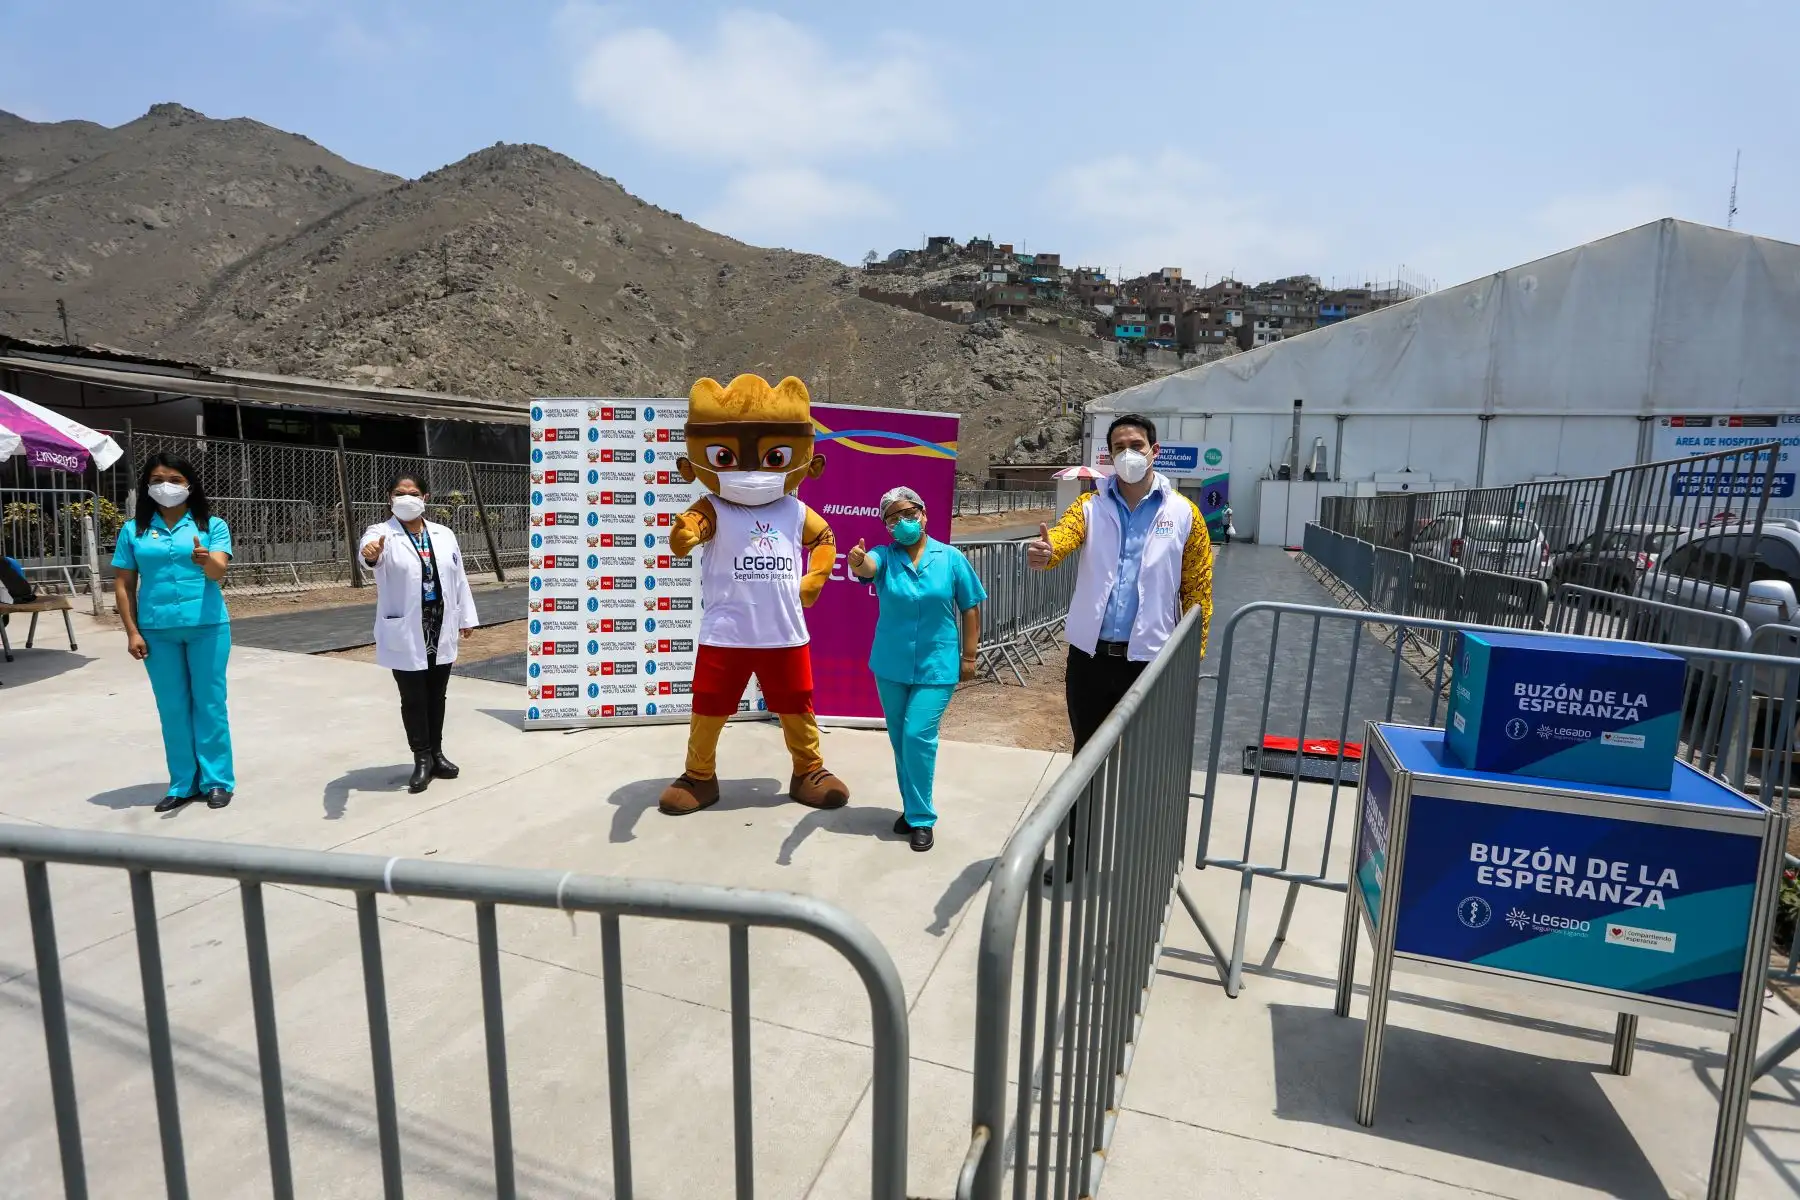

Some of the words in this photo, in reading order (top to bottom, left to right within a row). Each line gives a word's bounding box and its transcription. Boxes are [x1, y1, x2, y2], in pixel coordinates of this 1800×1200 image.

[1676, 436, 1701, 446] ÁREA
[1704, 438, 1716, 446] DE
[823, 504, 881, 517] #JUGAMO
[734, 572, 769, 582] Seguimos
[1514, 683, 1583, 701] BUZÓN
[1590, 690, 1616, 704] DE
[1622, 692, 1648, 708] LA
[1518, 698, 1639, 722] ESPERANZA
[1470, 842, 1576, 874] BUZÓN
[1586, 858, 1629, 882] DE
[1638, 864, 1680, 890] LA
[1477, 866, 1666, 910] ESPERANZA
[1626, 936, 1658, 945] esperanza
[1628, 930, 1672, 942] Compartiendo
